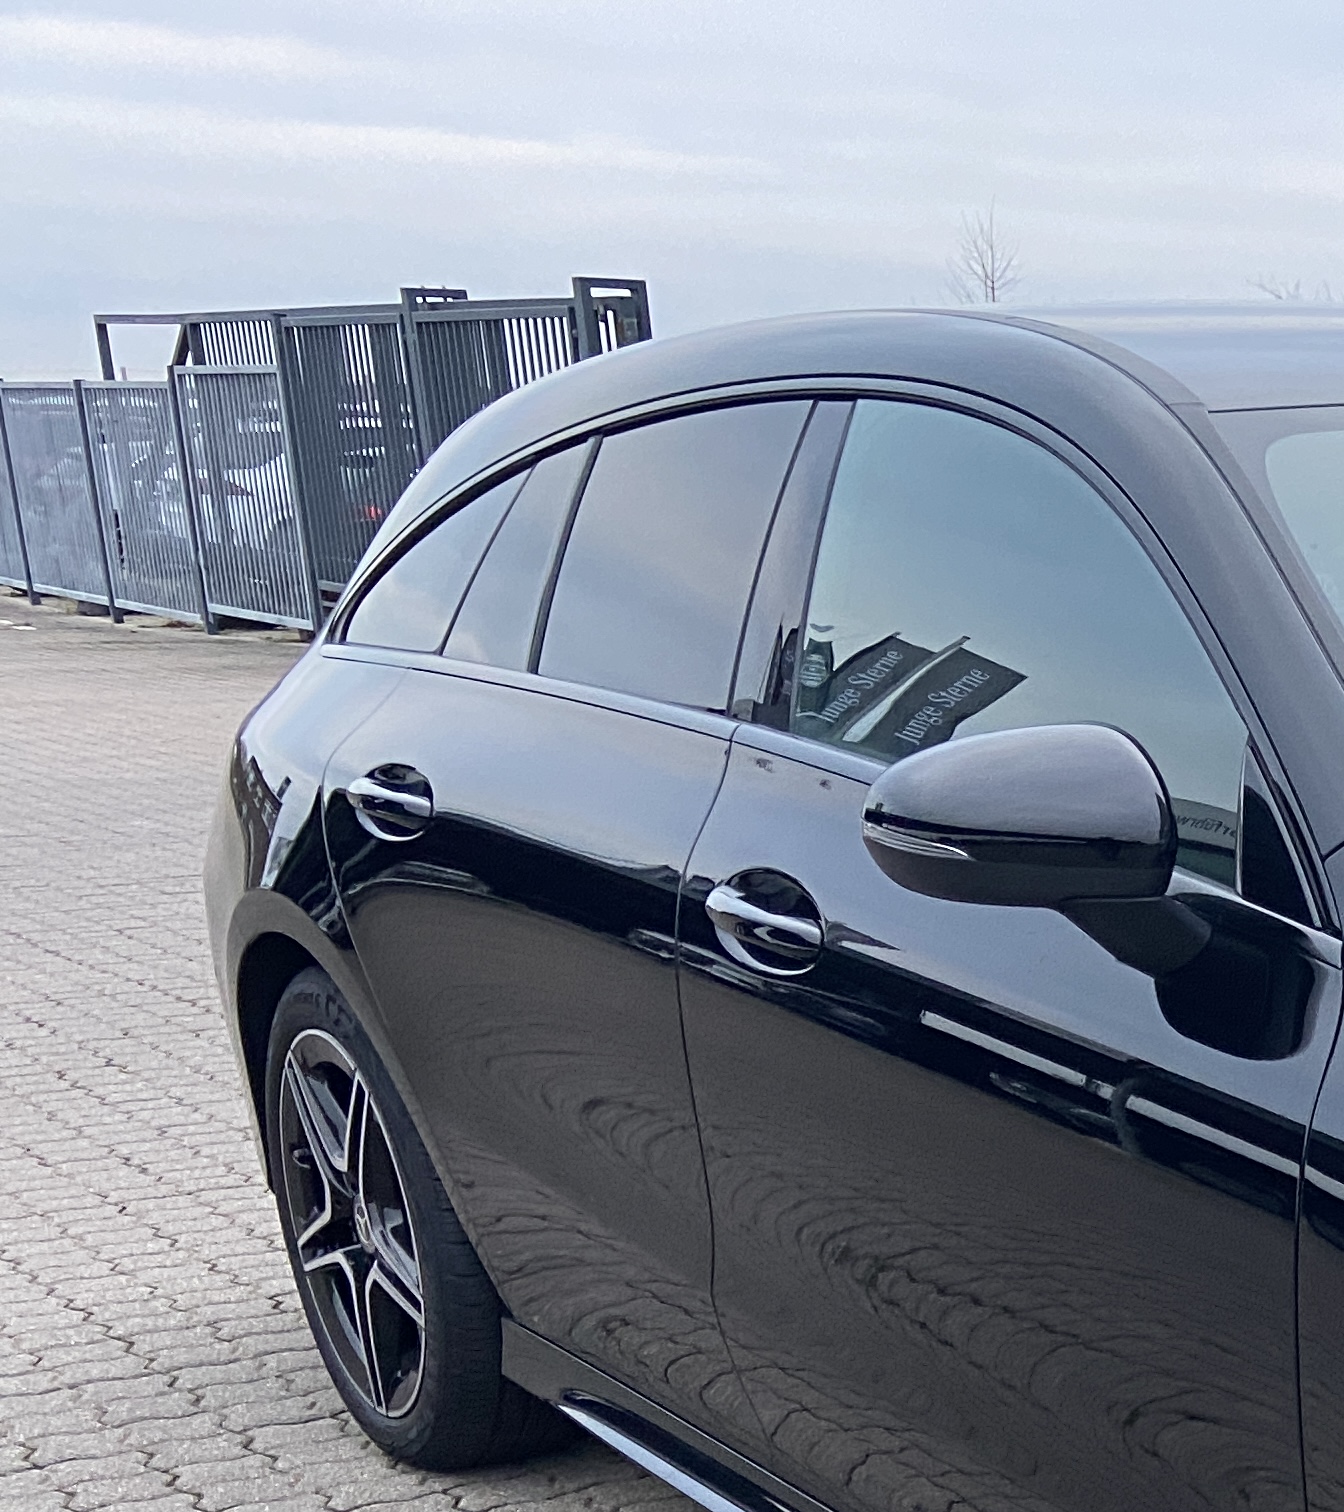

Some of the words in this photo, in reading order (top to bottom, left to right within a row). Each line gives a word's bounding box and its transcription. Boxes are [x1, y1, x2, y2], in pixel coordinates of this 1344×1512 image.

[820, 687, 861, 723] Junge
[847, 650, 903, 690] Sterne
[894, 705, 943, 746] Junge
[927, 668, 991, 708] Sterne
